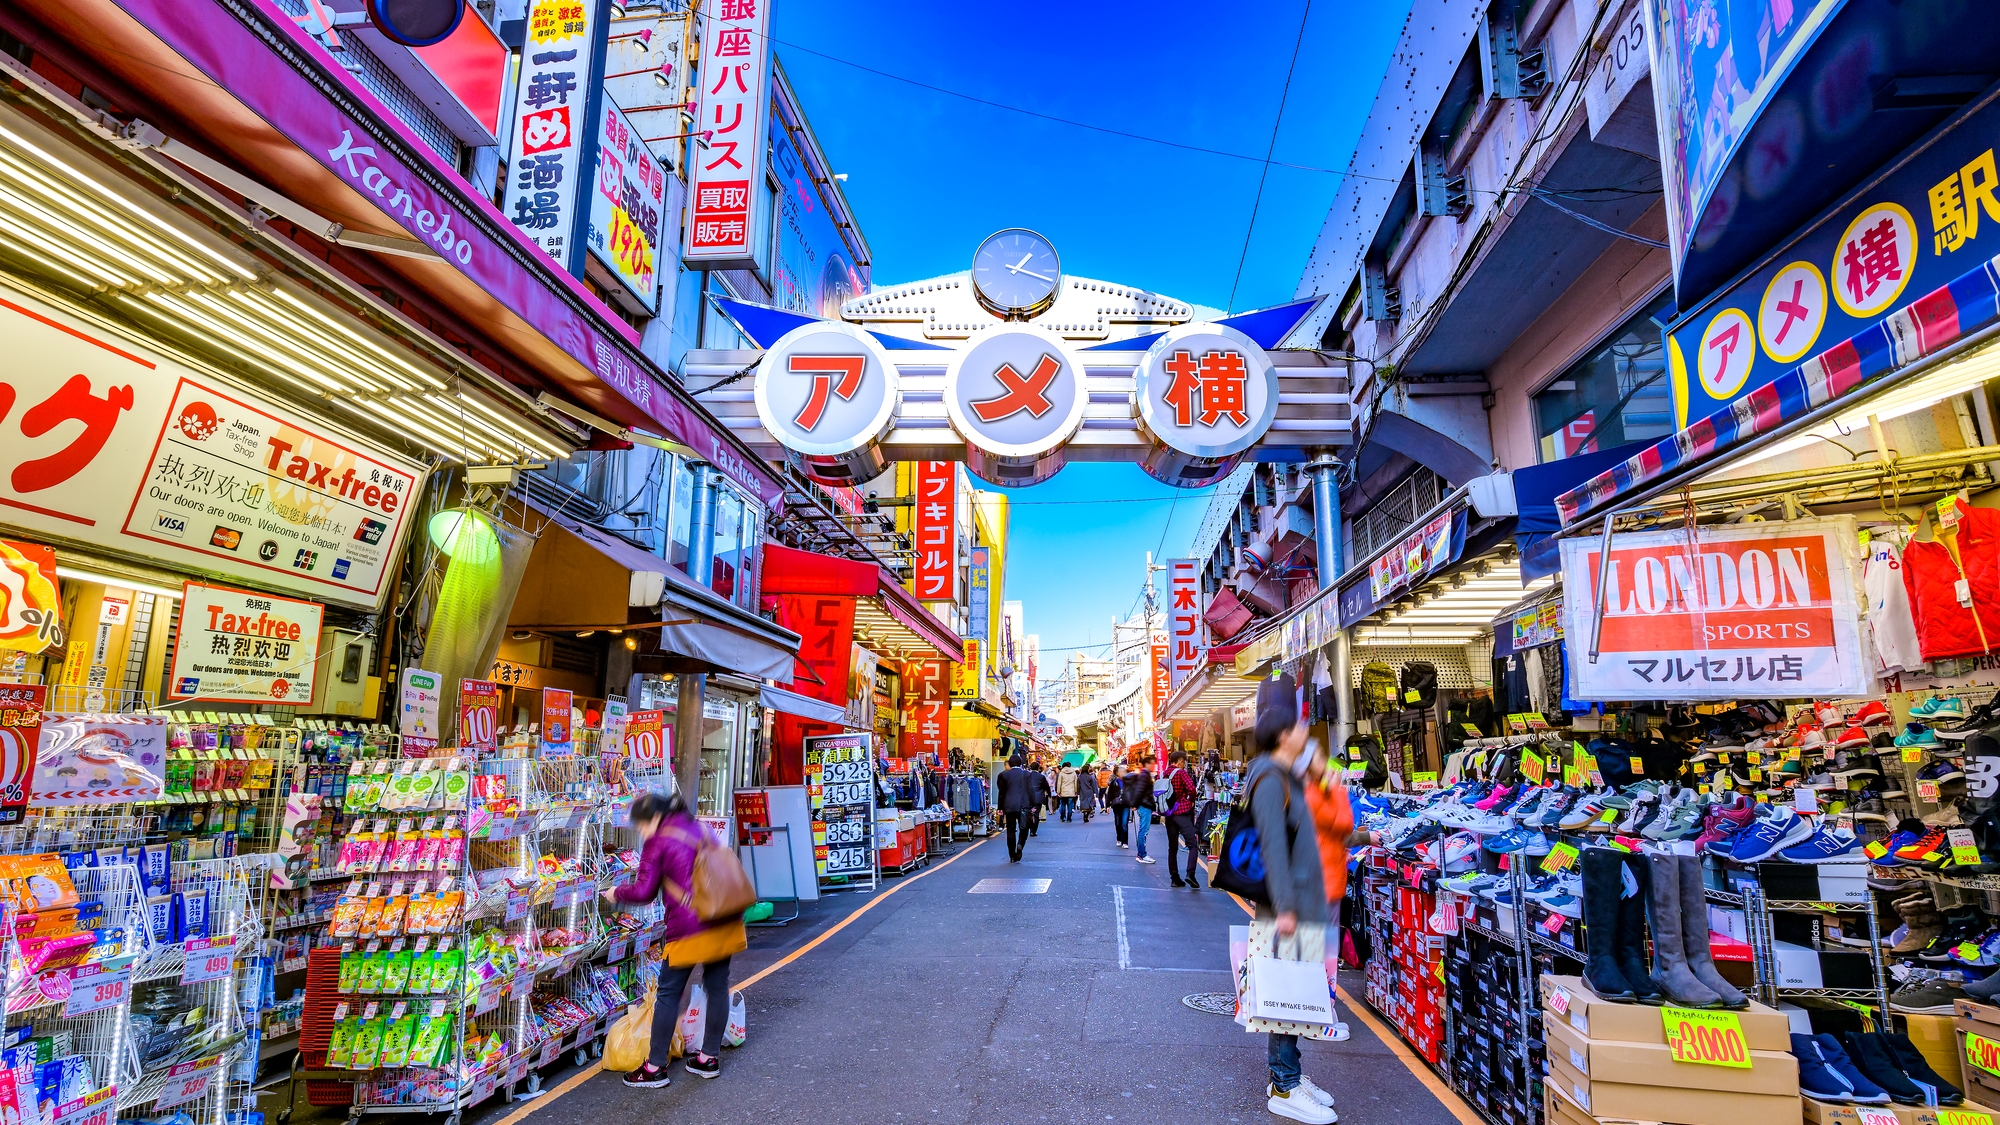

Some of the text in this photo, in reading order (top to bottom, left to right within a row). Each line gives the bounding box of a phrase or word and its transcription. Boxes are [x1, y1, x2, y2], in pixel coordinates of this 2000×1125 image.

[1602, 10, 1645, 94] 205
[328, 130, 473, 265] Kanebo
[699, 187, 745, 209] 買取
[695, 219, 744, 243] 販売
[595, 341, 652, 409] 雪肌精
[0, 374, 134, 494] グ
[225, 427, 259, 449] Tax-free
[232, 419, 261, 438] Japan.
[233, 443, 255, 458] Shop
[267, 436, 398, 514] Tax-free
[711, 435, 761, 495] Tax-free
[155, 453, 265, 510] 热烈欢迎
[150, 485, 341, 553] Our doors are open. Welcome to Japan!
[157, 515, 185, 532] VISA
[295, 553, 315, 566] JCB
[1603, 547, 1811, 617] LONDON
[207, 604, 300, 640] Tax-free
[1702, 621, 1811, 642] SPORTS
[211, 634, 290, 661] 热烈欢迎
[192, 663, 203, 672] Our
[204, 665, 222, 674] doors
[223, 667, 234, 675] are
[250, 669, 276, 678] Welcome
[1626, 655, 1803, 685] マルセル店
[959, 688, 974, 697] 入口
[466, 707, 492, 745] 10
[625, 731, 656, 761] 10
[815, 738, 859, 748] GINZA PARIS
[807, 746, 866, 765] 高額買取
[823, 762, 871, 781] 5923
[829, 823, 863, 842] 386
[830, 849, 864, 869] 345
[205, 956, 229, 973] 499
[94, 981, 123, 1003] 398
[1263, 1000, 1326, 1013] ISSEY MIYAKE SHIBUYA
[1670, 1021, 1745, 1062] ¥3000
[181, 1077, 206, 1097] 339
[1829, 1110, 1857, 1119] ellesse
